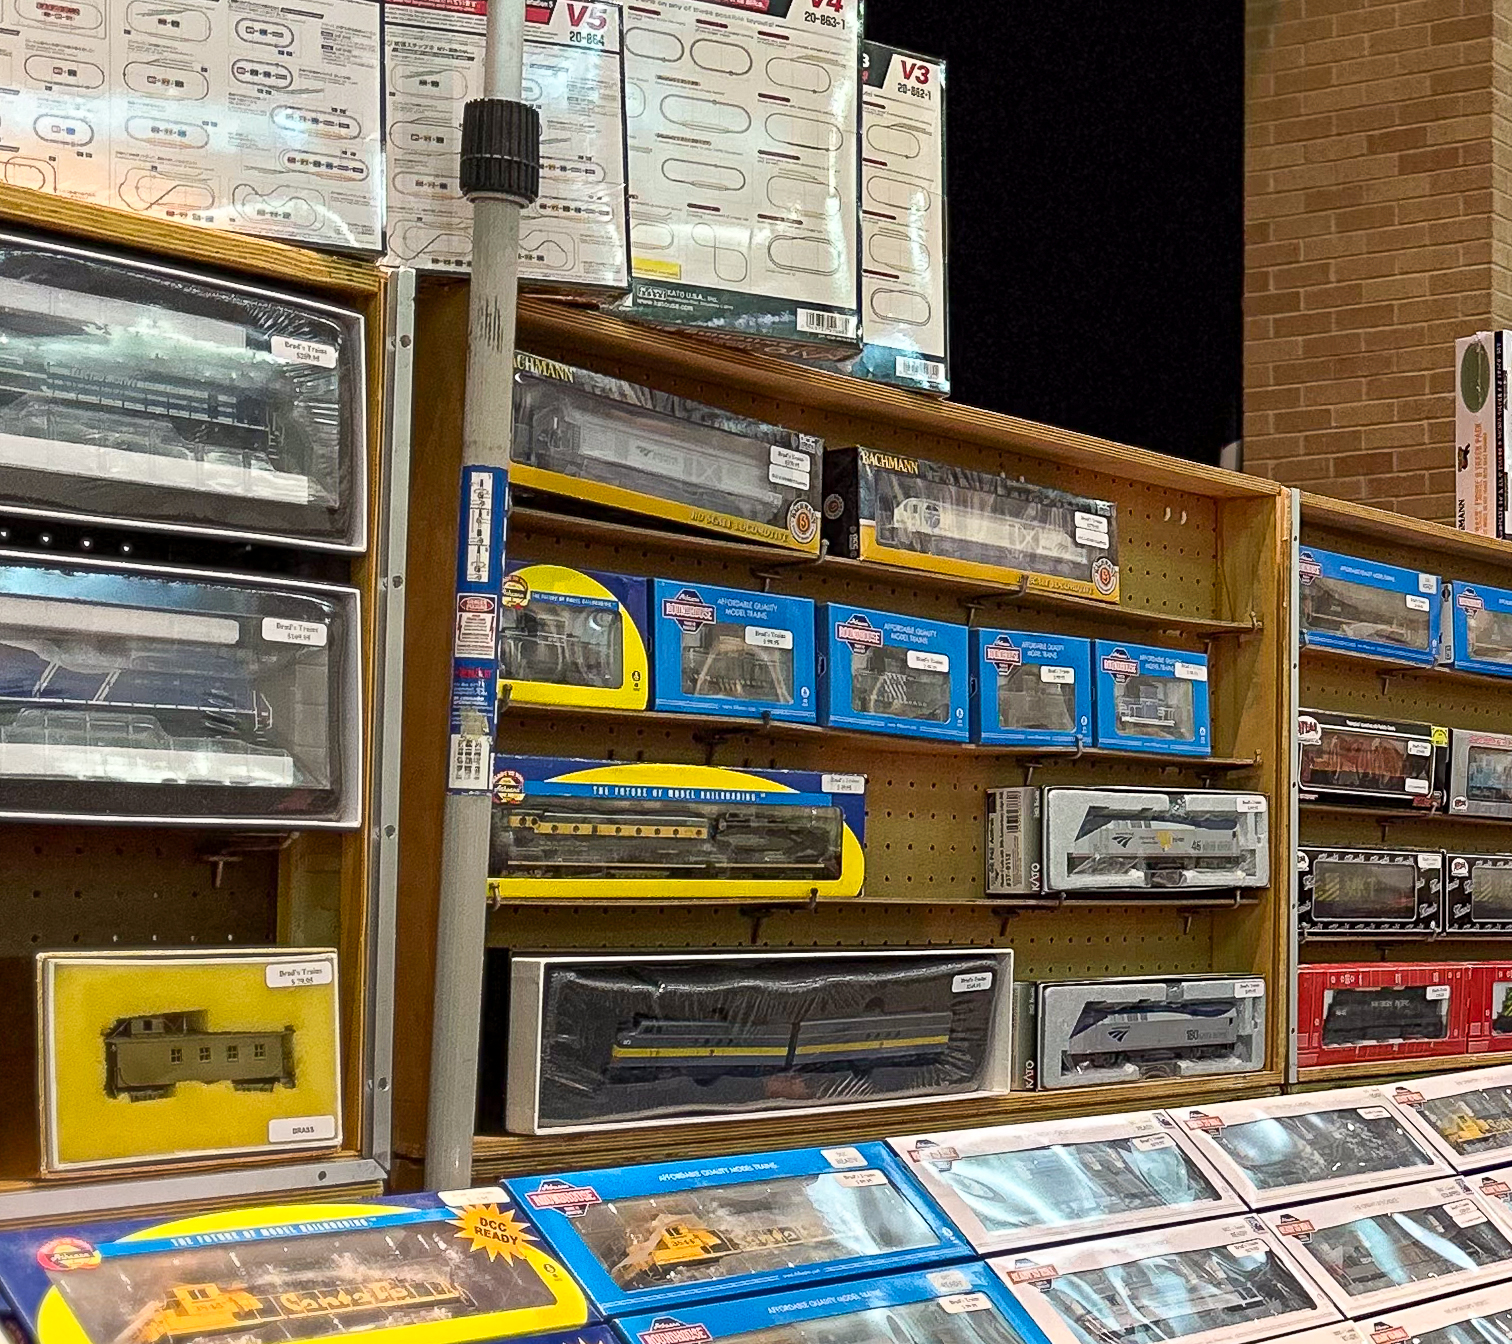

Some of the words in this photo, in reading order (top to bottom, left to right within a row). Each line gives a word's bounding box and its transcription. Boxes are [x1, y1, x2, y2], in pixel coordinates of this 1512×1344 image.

[566, 4, 607, 30] V5
[657, 0, 666, 7] on
[667, 1, 682, 12] any
[683, 4, 692, 13] of
[693, 6, 712, 18] these
[714, 11, 744, 25] possible
[804, 11, 846, 30] 20-863-1
[900, 59, 930, 85] V3
[308, 346, 328, 355] Trains
[861, 450, 919, 475] BACHMANN
[665, 602, 713, 620] ROUNDHOUSE
[717, 597, 753, 610] AFFORDABLE
[753, 602, 778, 613] QUALITY
[725, 608, 745, 617] MODEL
[298, 624, 319, 633] Trains
[884, 622, 915, 633] AFFORDABLE
[915, 627, 937, 638] QUALITY
[890, 632, 909, 642] MODEL
[592, 786, 609, 796] THE
[615, 786, 648, 798] FUTURE
[653, 787, 662, 798] OF
[668, 788, 696, 800] MODEL
[1030, 862, 1040, 891] KATO
[279, 969, 300, 977] Brad's
[301, 968, 322, 976] Trains
[1025, 1059, 1034, 1089] KATO
[834, 1156, 858, 1164] READY
[658, 1171, 699, 1182] AFFORDABLE
[700, 1168, 728, 1177] QUALITY
[729, 1165, 751, 1174] MODEL
[752, 1162, 778, 1171] TRAINS
[534, 1188, 599, 1208] ROUNDHOUSE
[479, 1216, 507, 1232] DCC
[170, 1237, 195, 1247] THE
[196, 1230, 238, 1244] FUTURE
[241, 1229, 256, 1239] OF
[260, 1225, 295, 1237] MODEL
[473, 1226, 518, 1246] READY
[280, 1288, 372, 1313] Santa
[767, 1301, 810, 1314] AFFORDABLE
[810, 1296, 837, 1307] QUALITY
[838, 1293, 860, 1303] MODEL
